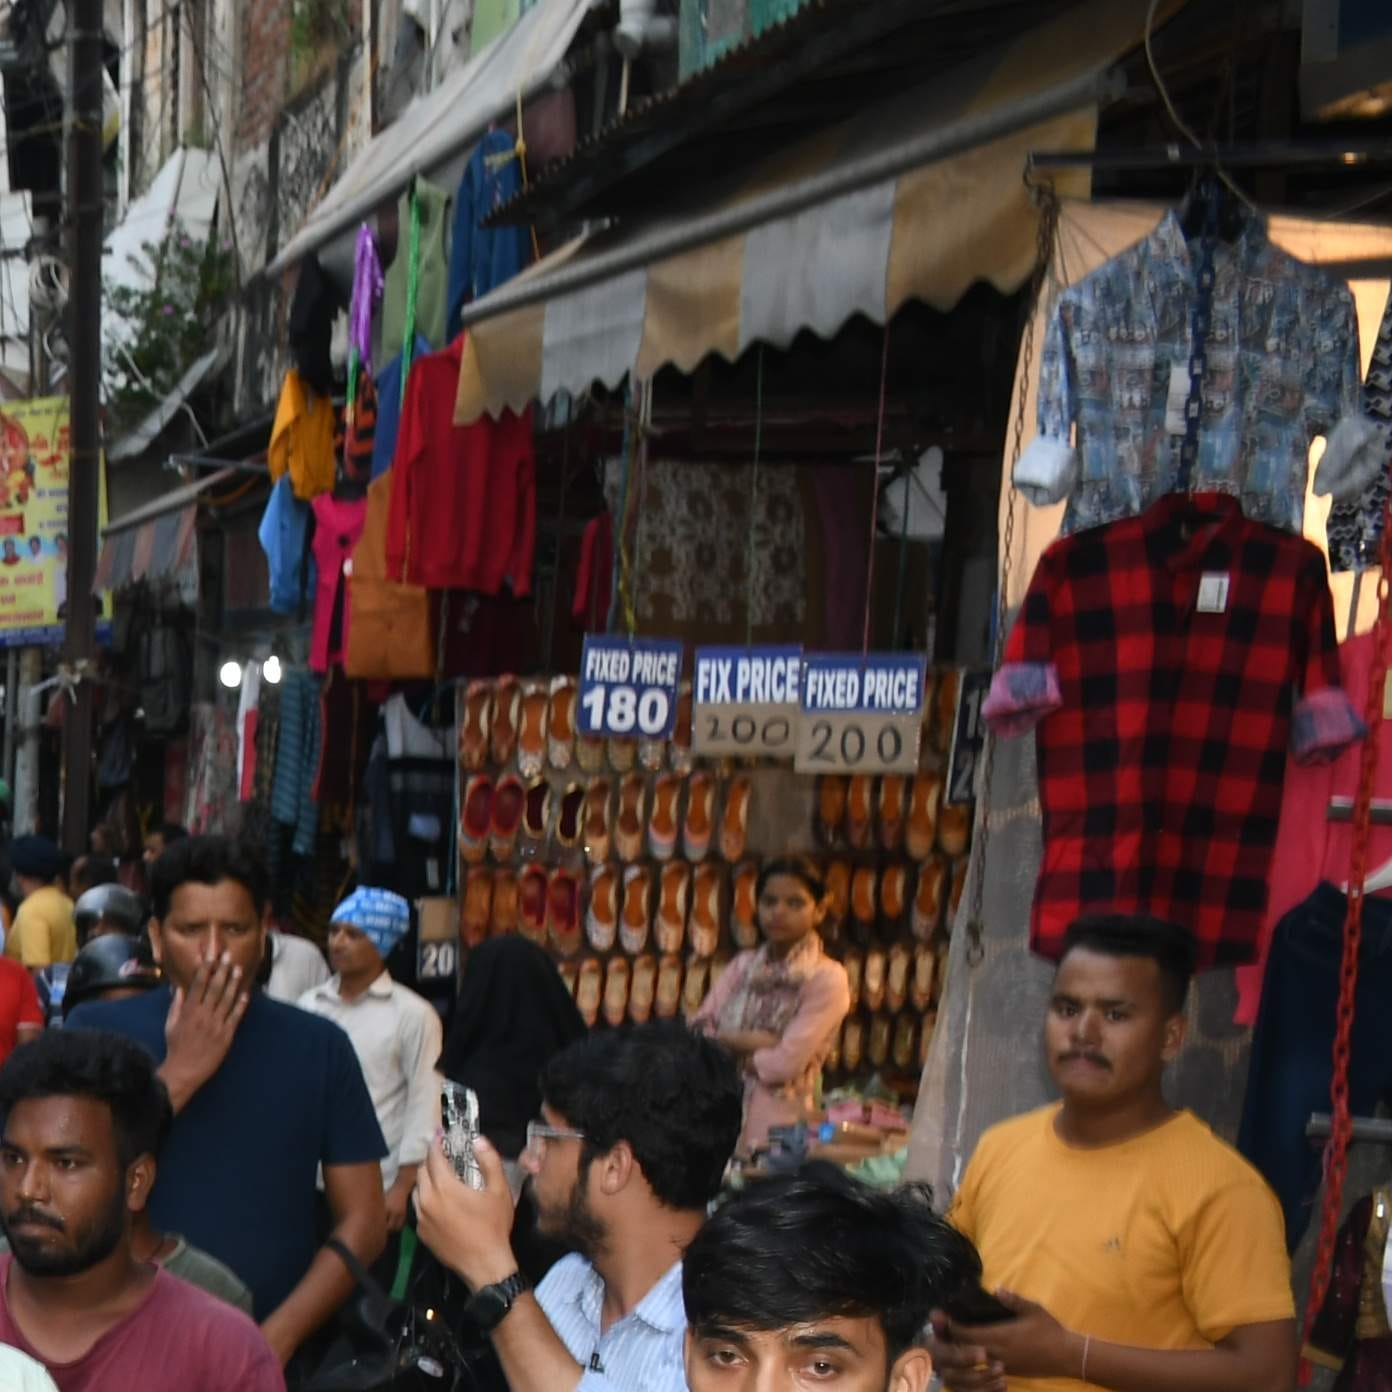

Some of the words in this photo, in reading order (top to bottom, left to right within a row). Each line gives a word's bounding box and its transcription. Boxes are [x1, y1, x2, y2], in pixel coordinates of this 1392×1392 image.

[585, 648, 630, 682] FIXED
[632, 650, 678, 686] PRICE
[698, 658, 733, 704] FIX
[736, 657, 801, 704] PRICE
[806, 669, 860, 708] FIXED
[863, 669, 918, 709] PRICE
[582, 686, 670, 735] 180
[810, 723, 903, 767] 200
